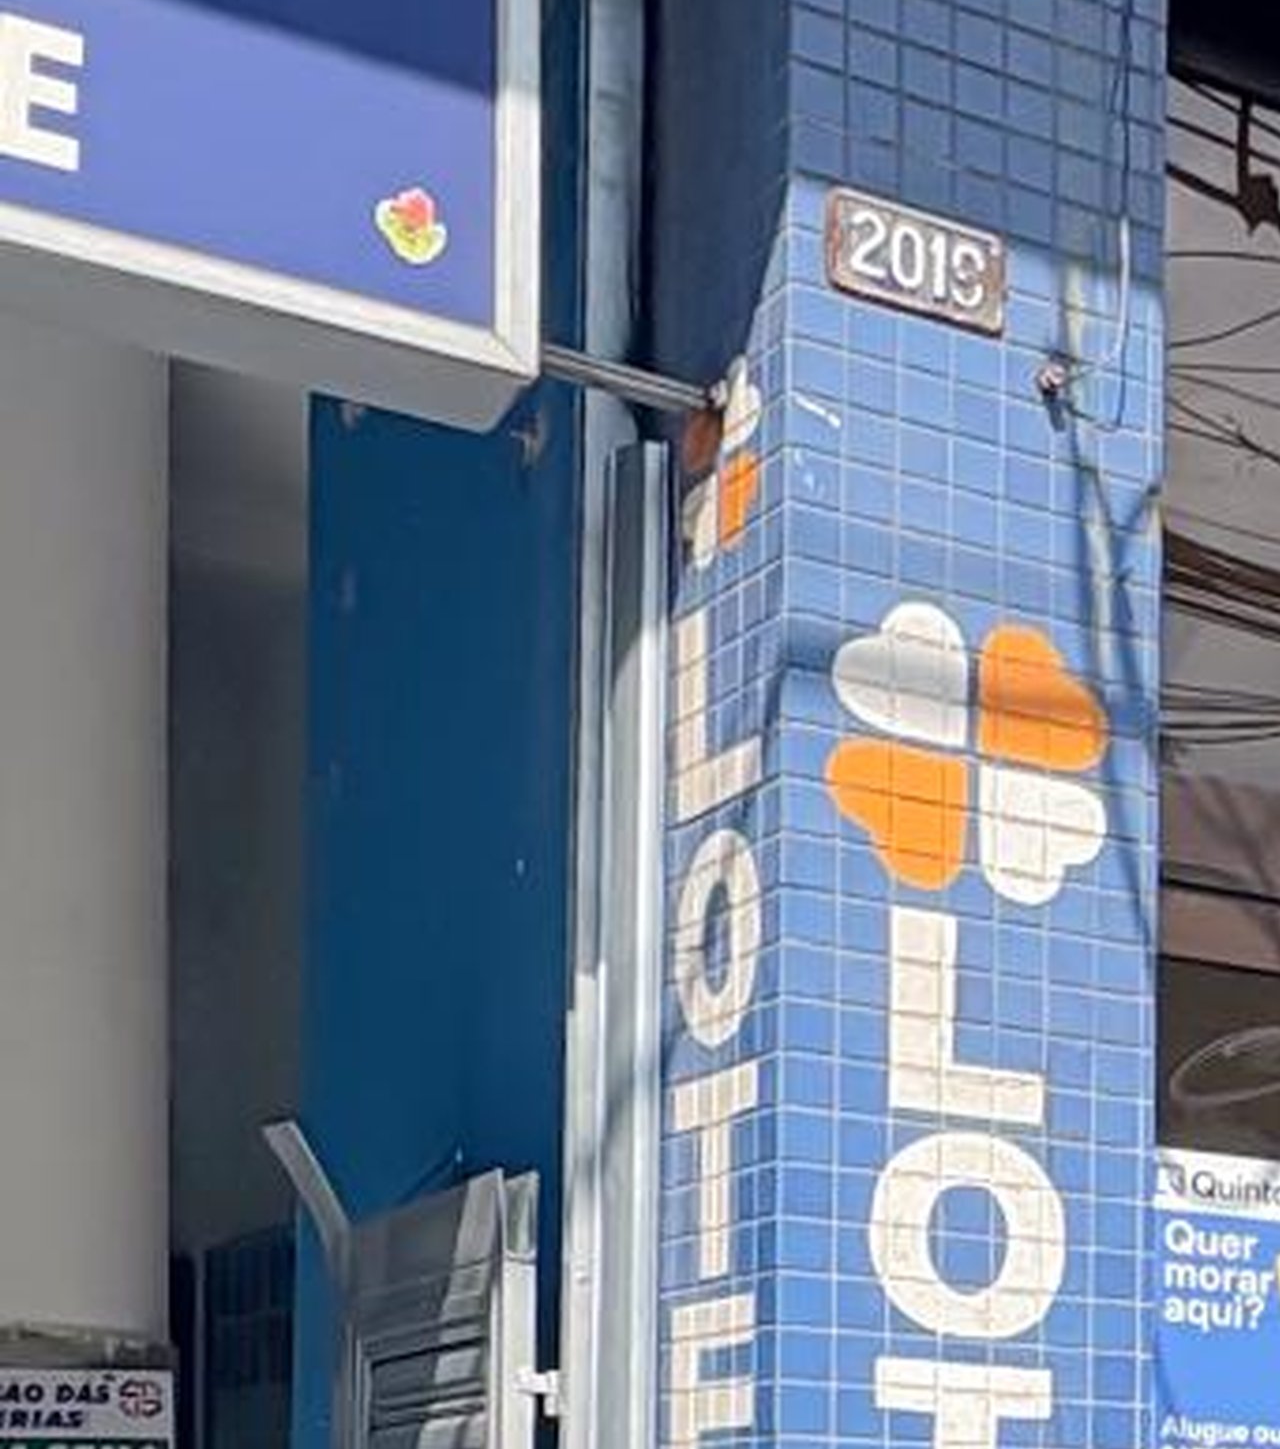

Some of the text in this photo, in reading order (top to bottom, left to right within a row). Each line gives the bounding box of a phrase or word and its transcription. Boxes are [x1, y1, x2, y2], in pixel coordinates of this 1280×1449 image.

[1163, 1219, 1259, 1262] Quer
[1163, 1260, 1275, 1294] morar
[1163, 1293, 1267, 1330] aqui?
[1159, 1415, 1249, 1446] Alugue
